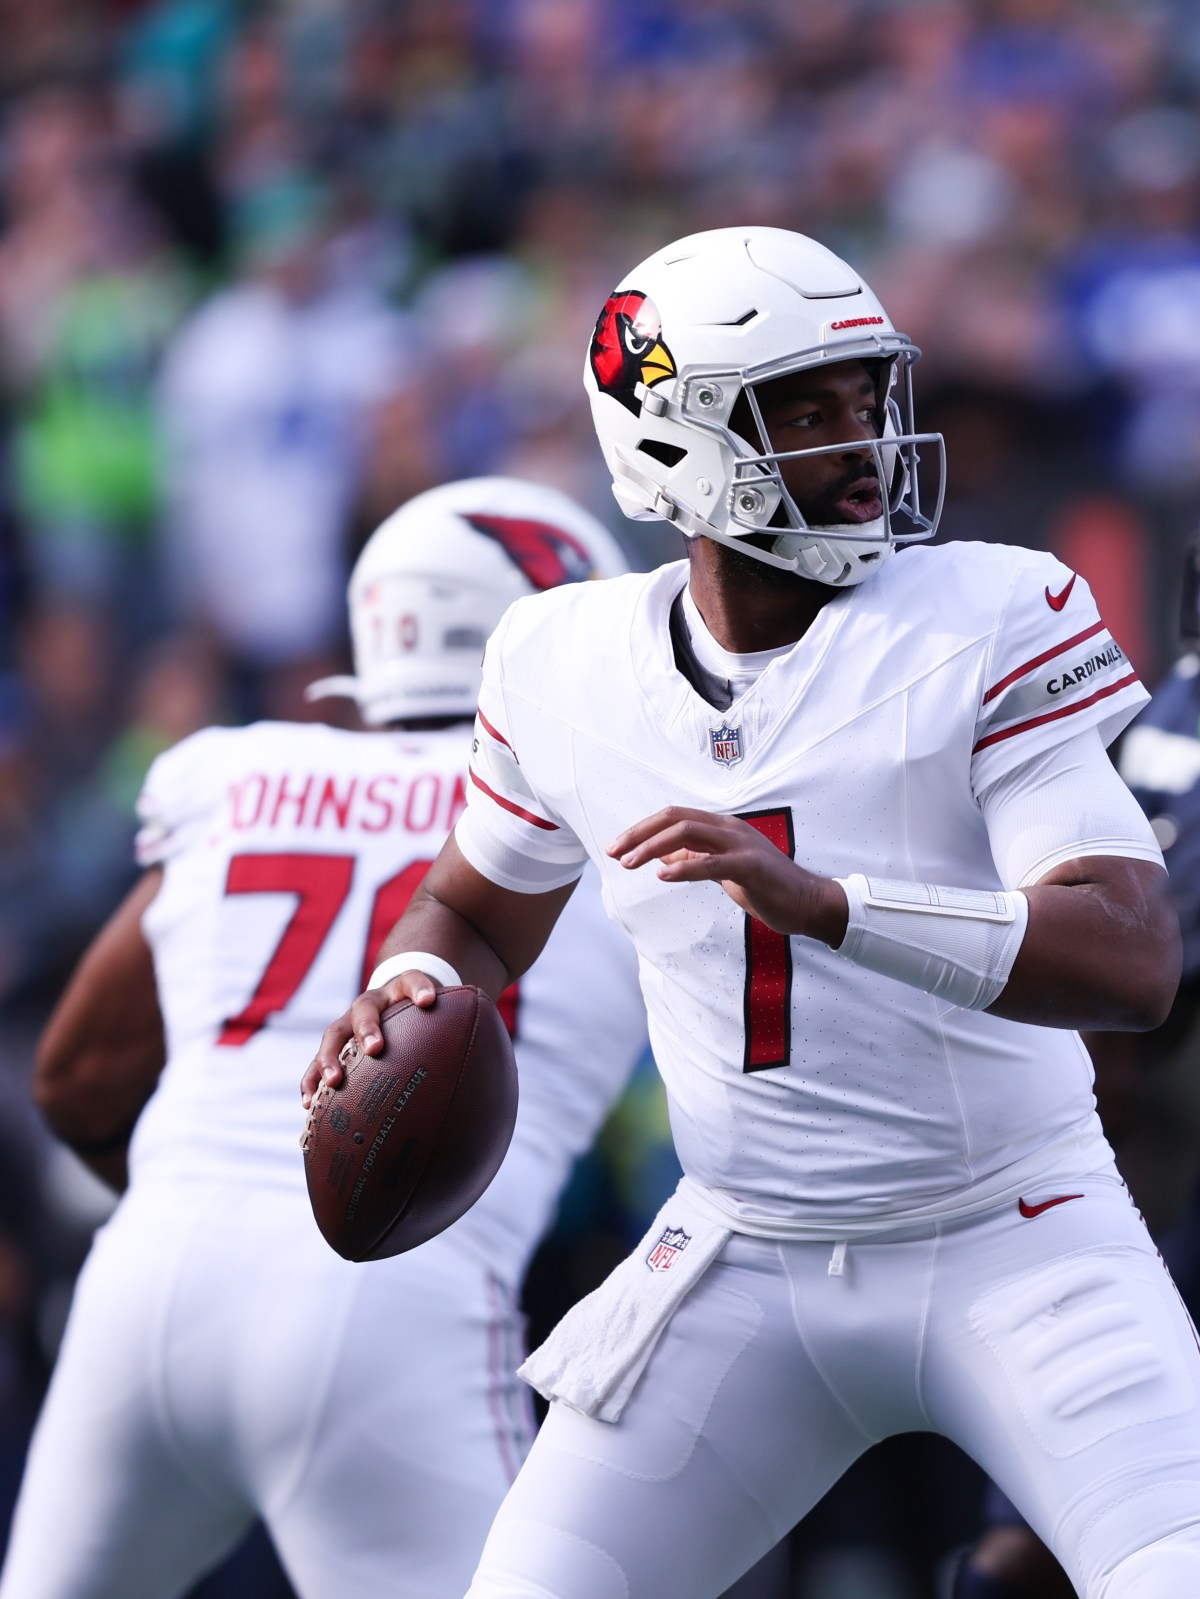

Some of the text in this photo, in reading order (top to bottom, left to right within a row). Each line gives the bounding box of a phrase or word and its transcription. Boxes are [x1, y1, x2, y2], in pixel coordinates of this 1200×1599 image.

[831, 316, 884, 330] CARDINALS
[1046, 644, 1122, 695] CARDINALS
[715, 742, 738, 760] NFL
[743, 806, 795, 1073] 1
[362, 1115, 396, 1173] FOOTBALL
[393, 1067, 428, 1113] LEAGUE
[650, 1244, 677, 1269] NFL
